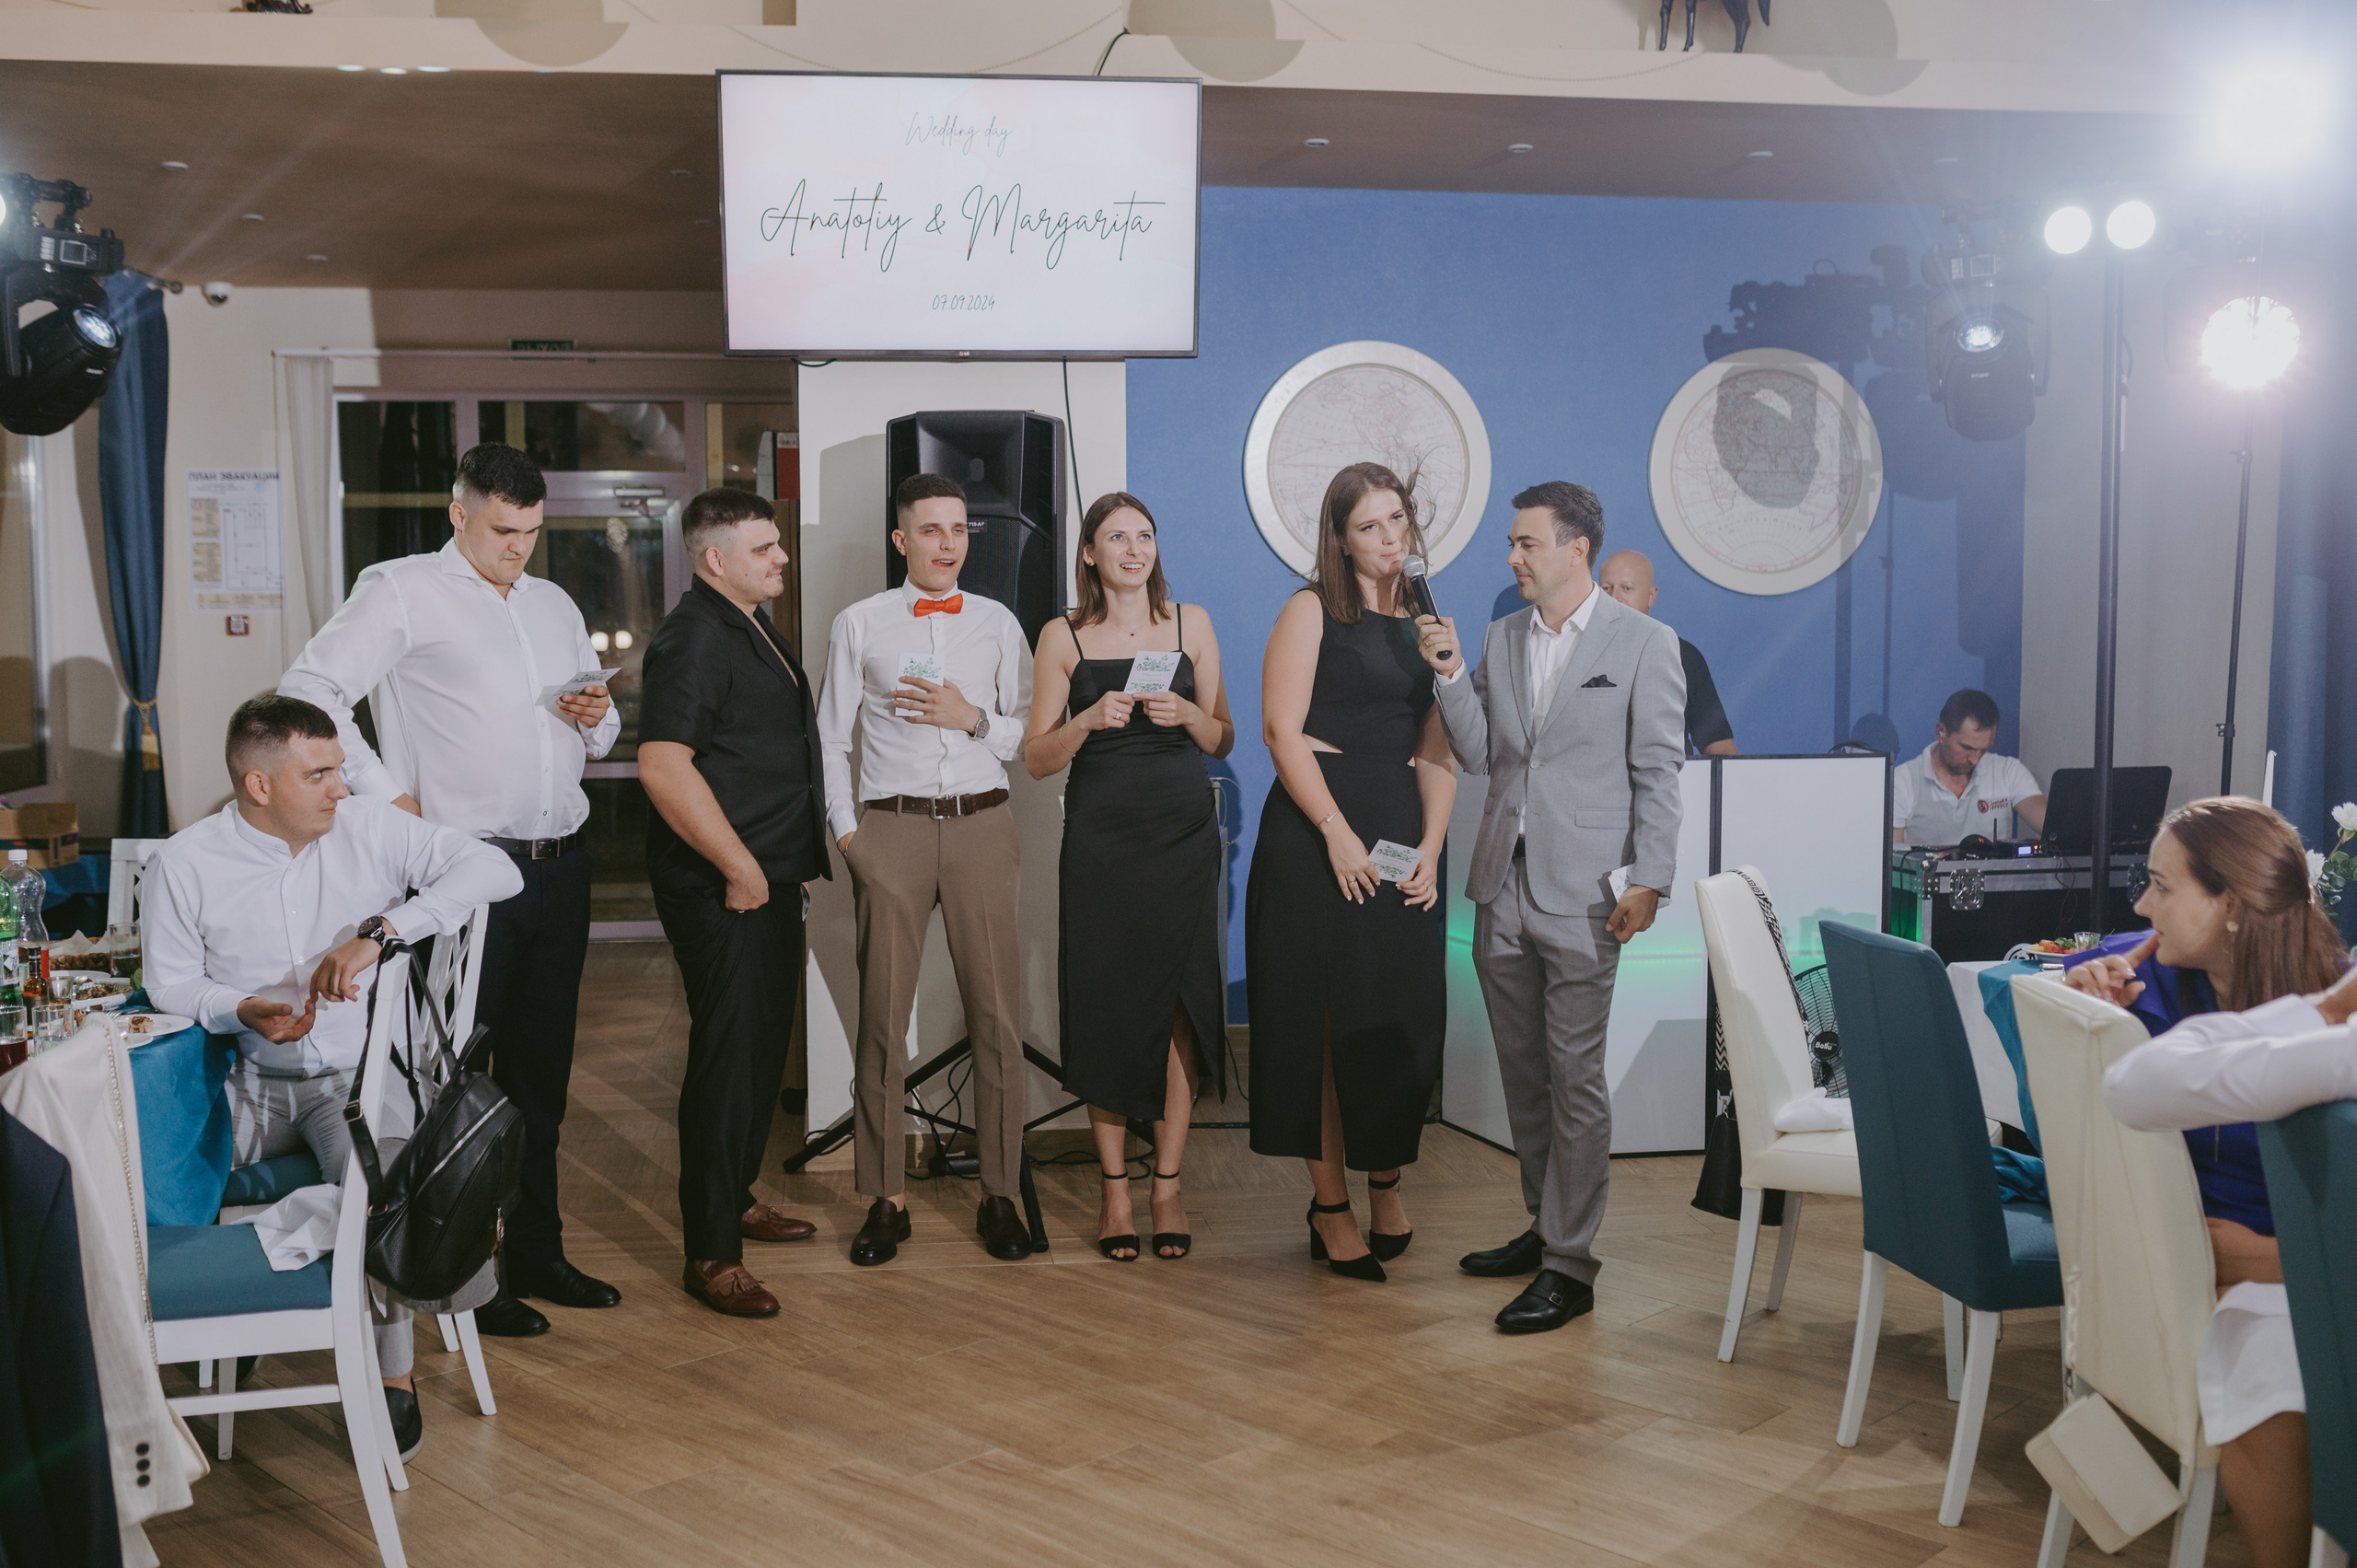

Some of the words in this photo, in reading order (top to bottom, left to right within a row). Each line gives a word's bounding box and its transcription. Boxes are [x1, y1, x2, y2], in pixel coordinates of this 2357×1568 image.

[905, 111, 980, 156] Wedding
[984, 115, 1014, 158] day
[924, 203, 946, 235] &
[961, 183, 1166, 270] Margarita
[932, 294, 995, 310] 07.09.2024
[1815, 1041, 1832, 1051] Ballu
